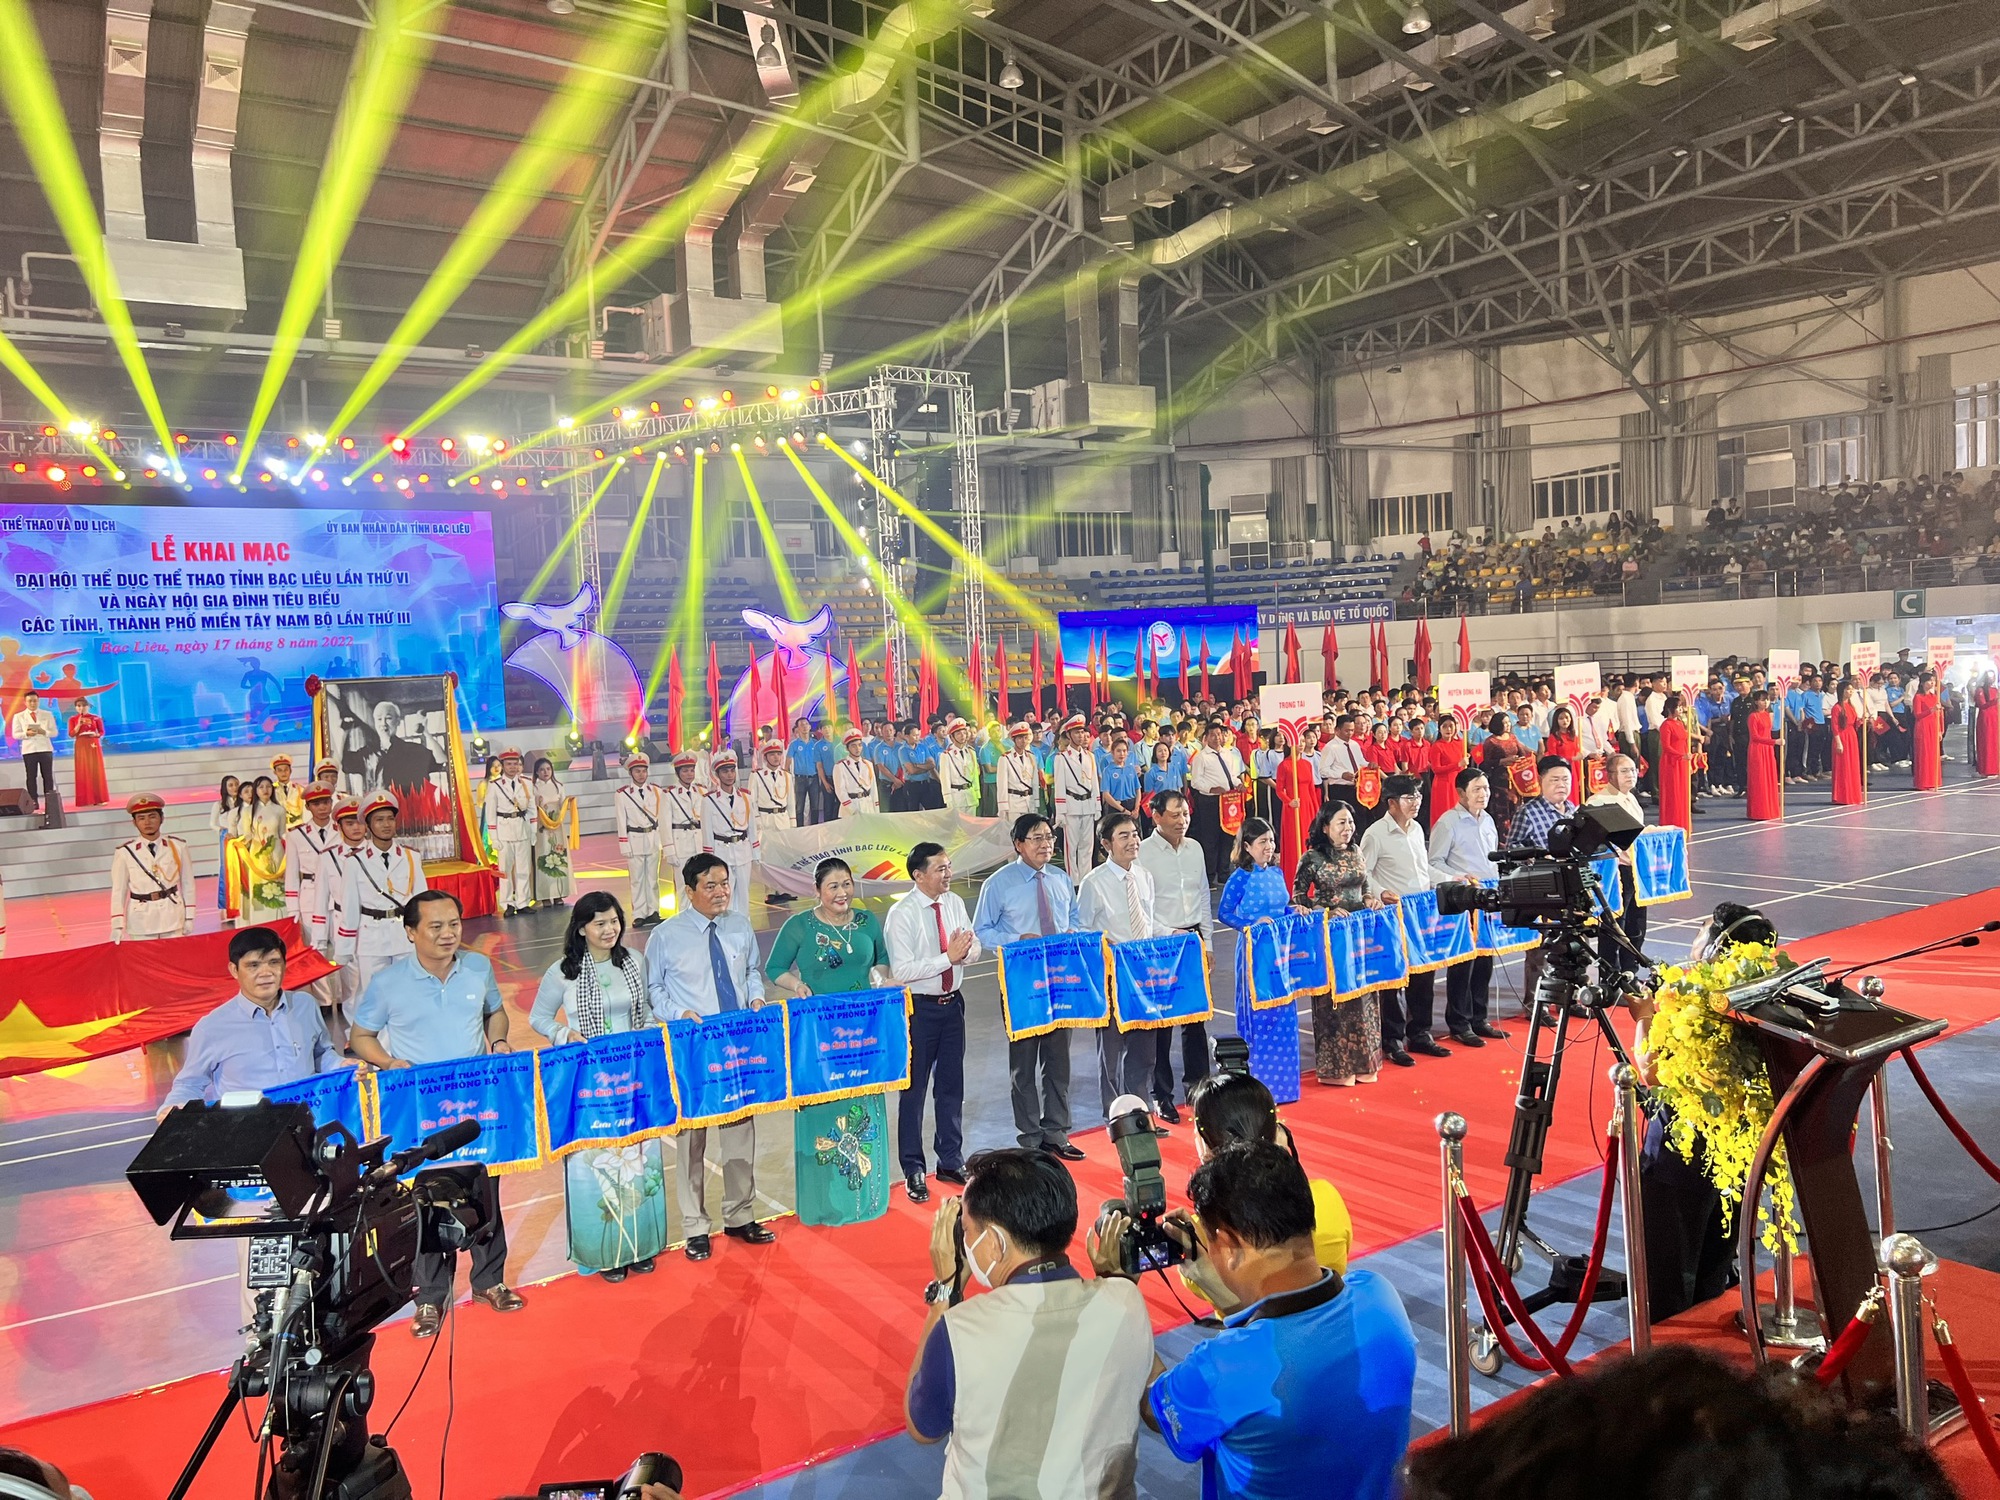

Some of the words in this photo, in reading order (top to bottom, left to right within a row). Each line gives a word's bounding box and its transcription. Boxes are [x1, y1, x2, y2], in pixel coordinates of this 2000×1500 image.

[26, 520, 53, 532] THAO
[56, 517, 71, 532] VÀ
[75, 520, 89, 532] DU
[92, 520, 116, 536] LỊCH
[342, 523, 359, 535] BAN
[363, 521, 387, 535] NHÂN
[390, 521, 408, 535] DÂN
[433, 525, 449, 539] BẠC
[452, 523, 470, 536] LIÊU
[151, 534, 178, 562] LỄ
[183, 541, 235, 562] KHAI
[242, 541, 291, 566] MẠC
[15, 573, 44, 590] ĐẠI
[50, 571, 77, 591] HỘI
[82, 569, 112, 588] THỂ
[116, 573, 149, 590] DỤC
[153, 568, 183, 588] THỂ
[186, 573, 226, 587] THAO
[229, 568, 264, 587] TỈNH
[268, 572, 298, 590] BẠC
[301, 571, 332, 586] LIÊU
[336, 569, 363, 586] LẦN
[366, 571, 393, 585] THỨ
[397, 571, 409, 585] VI
[99, 593, 121, 610] VÀ
[124, 593, 168, 609] NGÀY
[172, 592, 198, 611] HỘI
[203, 594, 230, 609] GIA
[233, 592, 269, 608] ĐÌNH
[272, 592, 304, 607] TIÊU
[308, 588, 341, 607] BIỂU
[1901, 593, 1918, 615] C
[21, 616, 56, 634] CÁC
[60, 615, 103, 634] TỈNH,
[108, 615, 161, 632] THÀNH
[165, 612, 197, 631] PHỐ
[201, 612, 240, 631] MIỀN
[244, 612, 272, 629] TÂY
[276, 614, 310, 629] NAM
[314, 613, 334, 631] BỘ
[337, 610, 365, 627] LẦN
[367, 611, 393, 626] THỨ
[397, 612, 411, 625] III
[1297, 609, 1310, 623] VÀ
[1312, 606, 1332, 621] BẢO
[1334, 606, 1346, 622] VỆ
[1348, 603, 1362, 620] TỔ
[1363, 602, 1389, 620] QUỐC
[101, 642, 130, 655] Bạc
[174, 640, 209, 656] ngày
[214, 638, 232, 651] 17
[235, 637, 273, 652] tháng
[277, 637, 285, 649] 8
[290, 637, 318, 650] năm
[322, 636, 354, 648] 2022
[818, 1012, 835, 1022] VĂN
[837, 1009, 866, 1021] PHÒNG
[868, 1005, 878, 1018] BỘ
[703, 1030, 724, 1041] VĂN
[757, 1023, 769, 1035] BỘ
[599, 1053, 632, 1067] PHÒNG
[458, 1069, 481, 1080] THAO
[303, 1089, 316, 1099] VÀ
[319, 1087, 332, 1096] DU
[420, 1084, 442, 1096] VĂN
[444, 1078, 482, 1092] PHÒNG
[484, 1076, 500, 1089] BỘ
[420, 1119, 437, 1130] Gia
[478, 1108, 500, 1121] biểu
